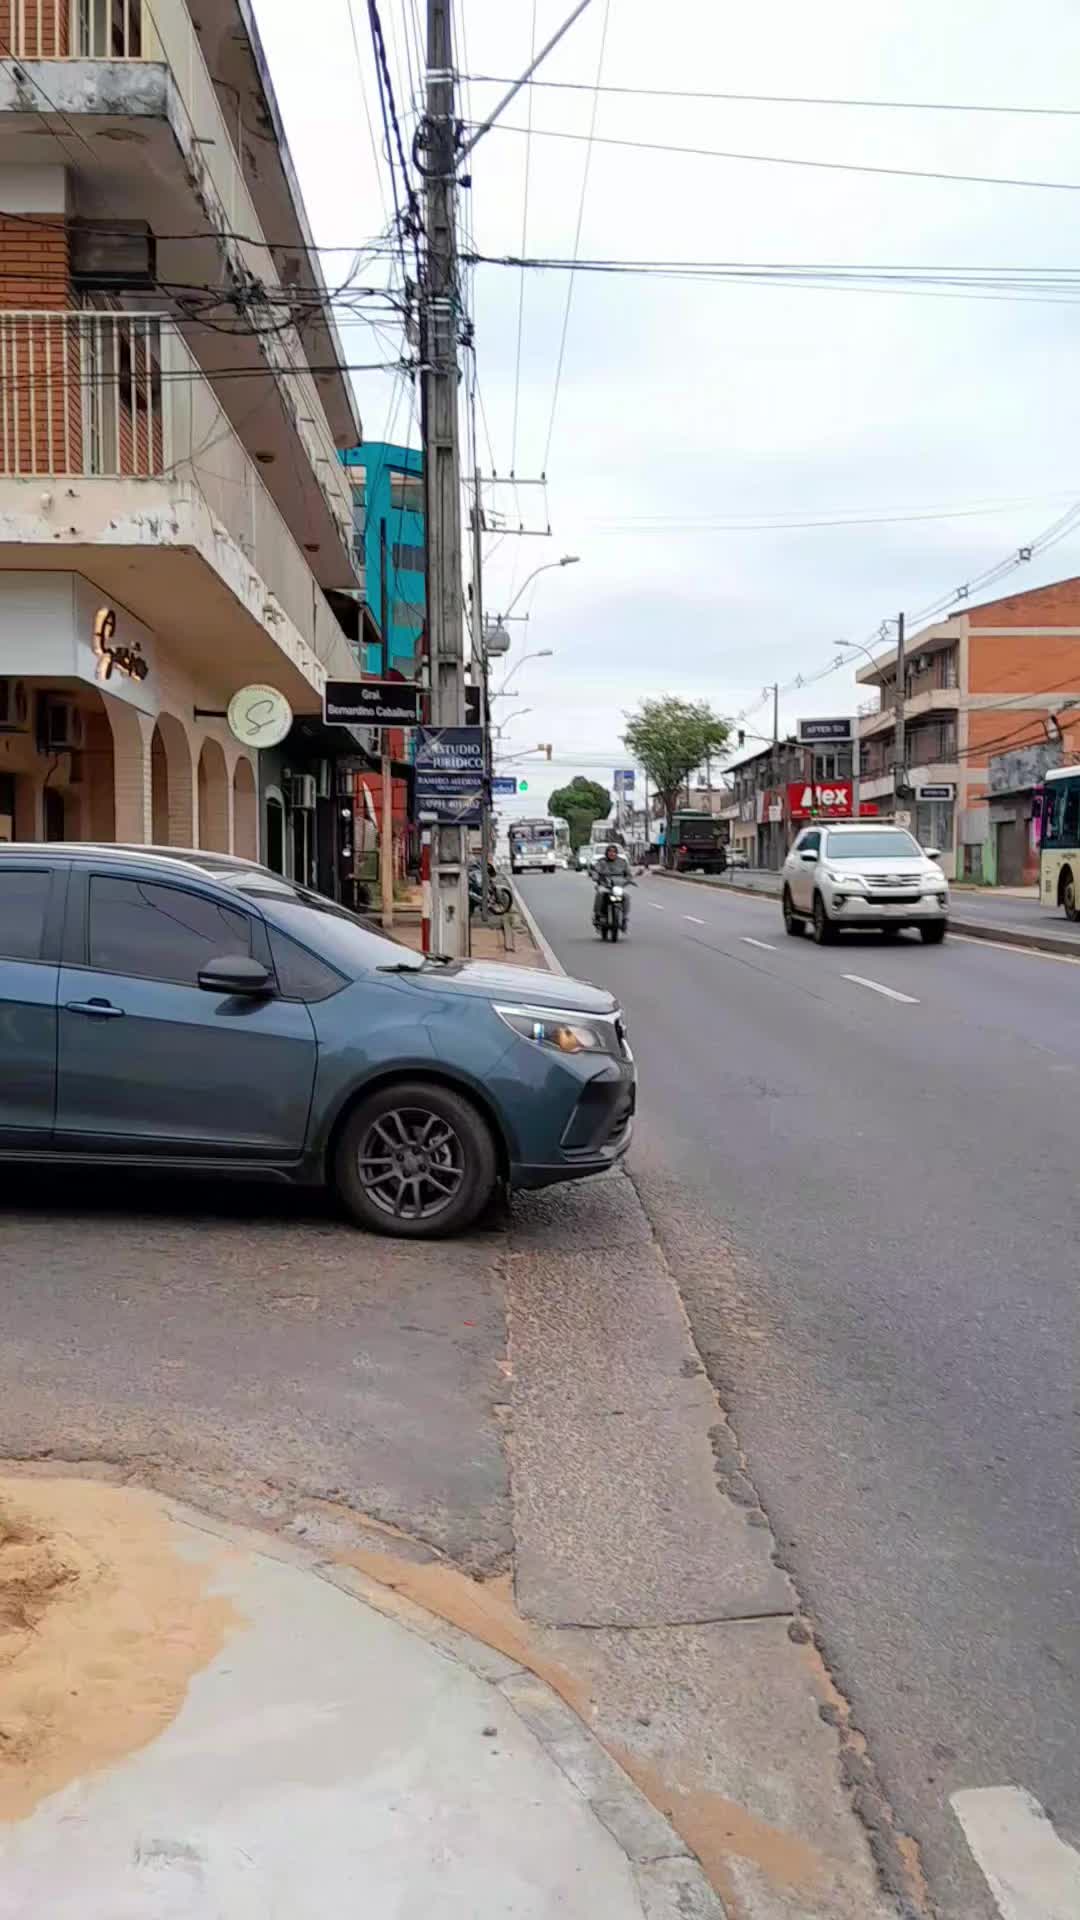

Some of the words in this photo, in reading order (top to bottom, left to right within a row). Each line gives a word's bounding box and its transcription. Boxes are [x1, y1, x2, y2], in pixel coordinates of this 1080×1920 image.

[361, 688, 382, 700] Gral.
[327, 704, 375, 716] Bernardino
[376, 706, 416, 718] Caballero
